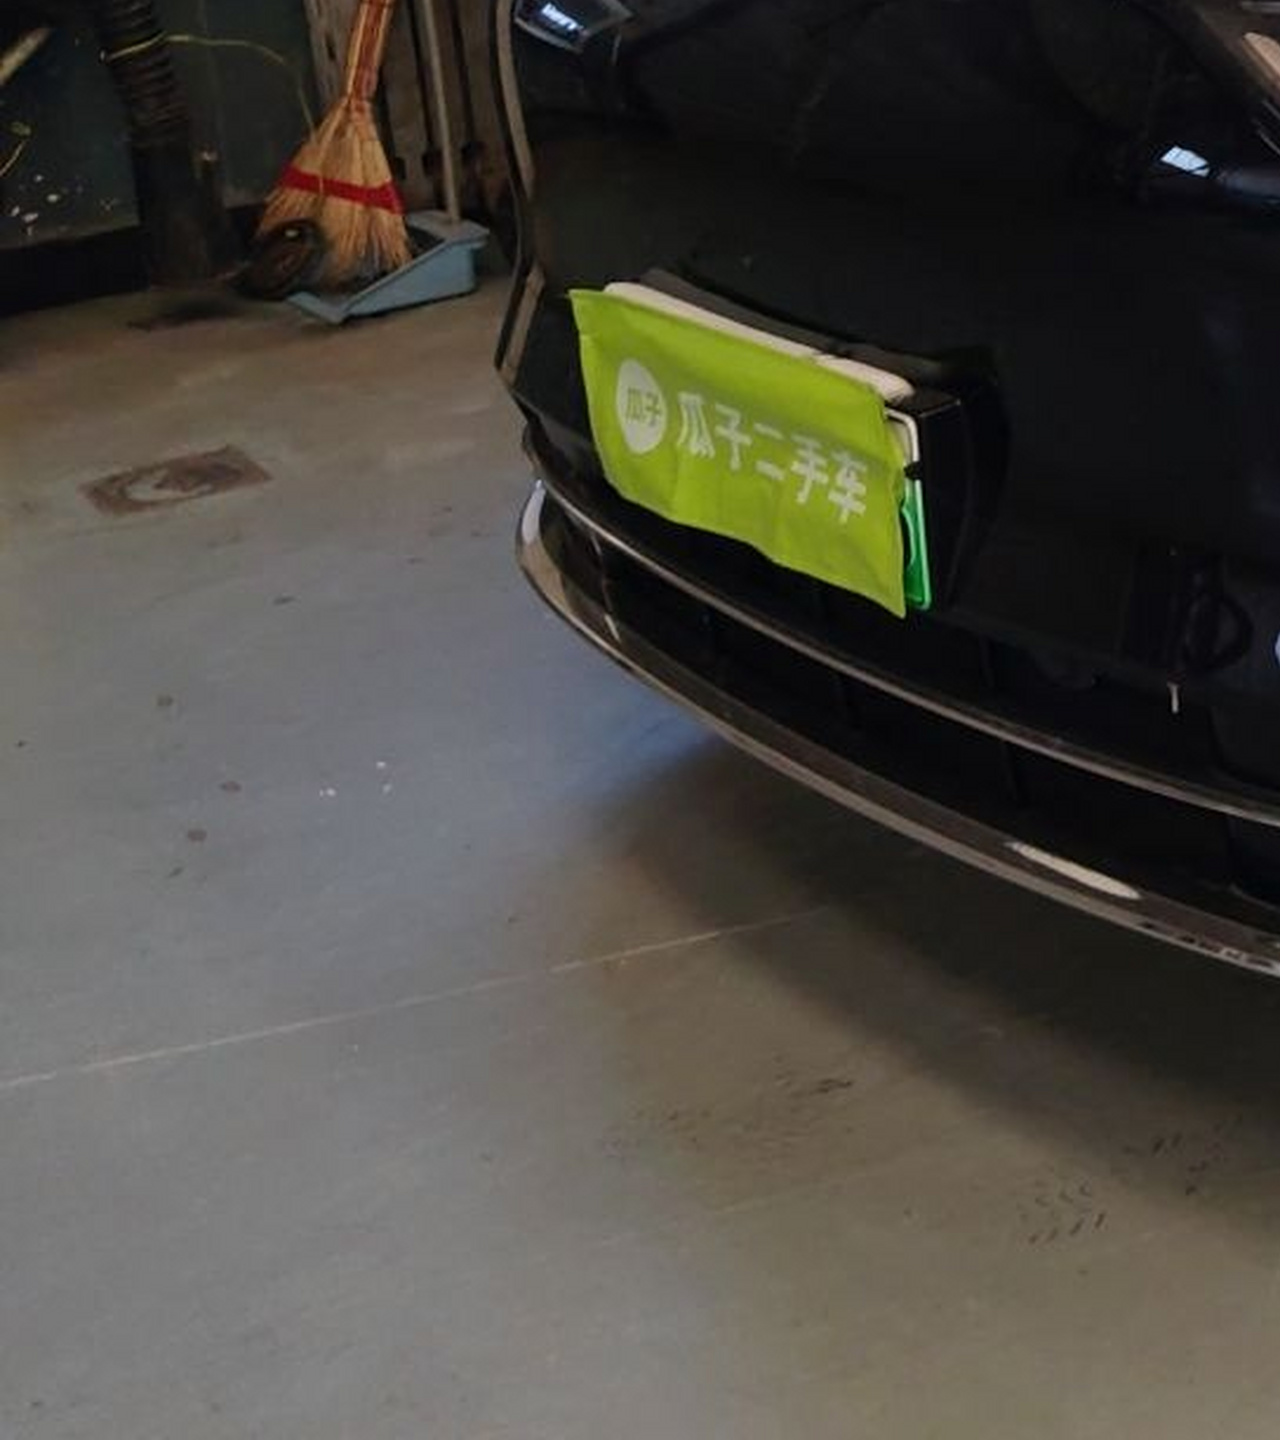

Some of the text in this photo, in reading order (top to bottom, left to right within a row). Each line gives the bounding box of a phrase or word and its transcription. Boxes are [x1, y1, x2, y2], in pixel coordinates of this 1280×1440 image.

[625, 386, 662, 429] 瓜子
[676, 390, 868, 523] 瓜子二手车
